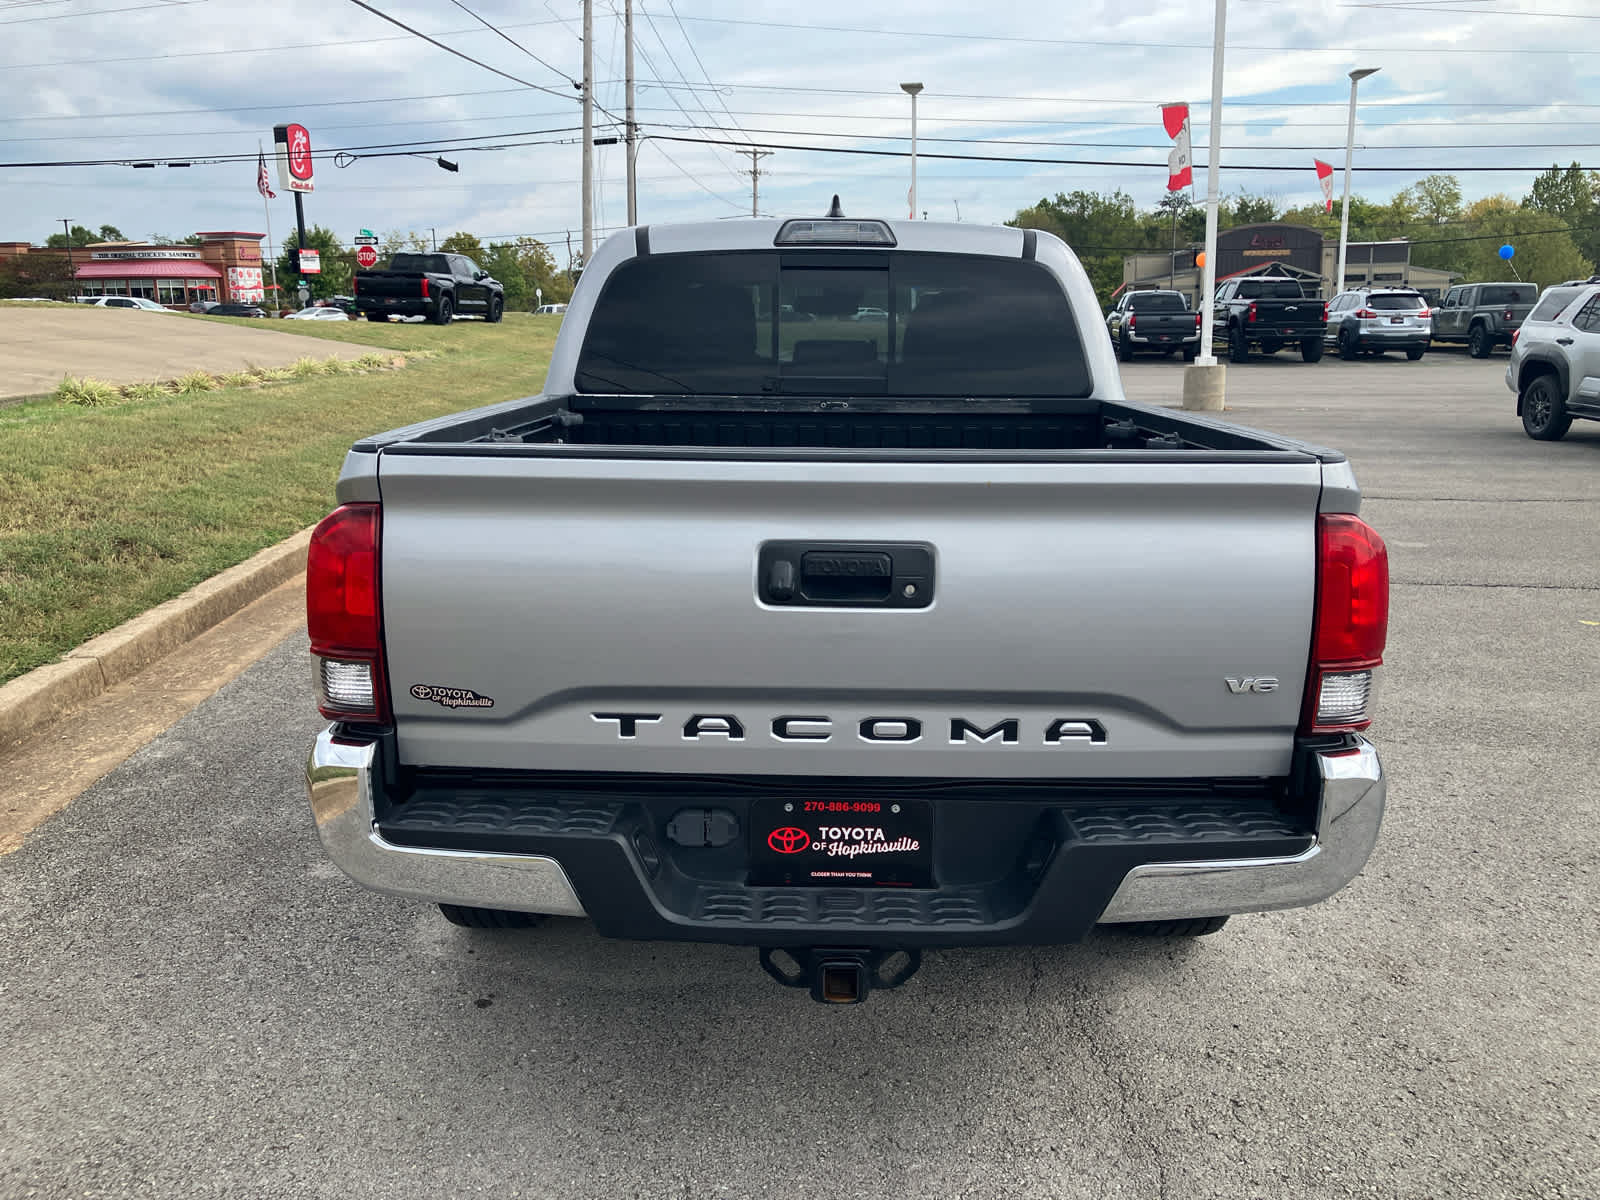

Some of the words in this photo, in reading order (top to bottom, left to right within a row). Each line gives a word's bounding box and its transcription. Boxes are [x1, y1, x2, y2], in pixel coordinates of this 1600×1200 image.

[358, 252, 376, 261] STOP
[806, 558, 887, 575] TOYOTA
[1224, 676, 1279, 694] V6
[432, 687, 474, 699] TOYOTA
[441, 697, 493, 707] Hopkinsville
[590, 713, 1108, 746] TACOMA
[804, 801, 881, 812] 270-886-9099
[819, 827, 885, 841] TOYOTA
[812, 842, 827, 851] OF
[827, 837, 920, 859] Hopkinsville
